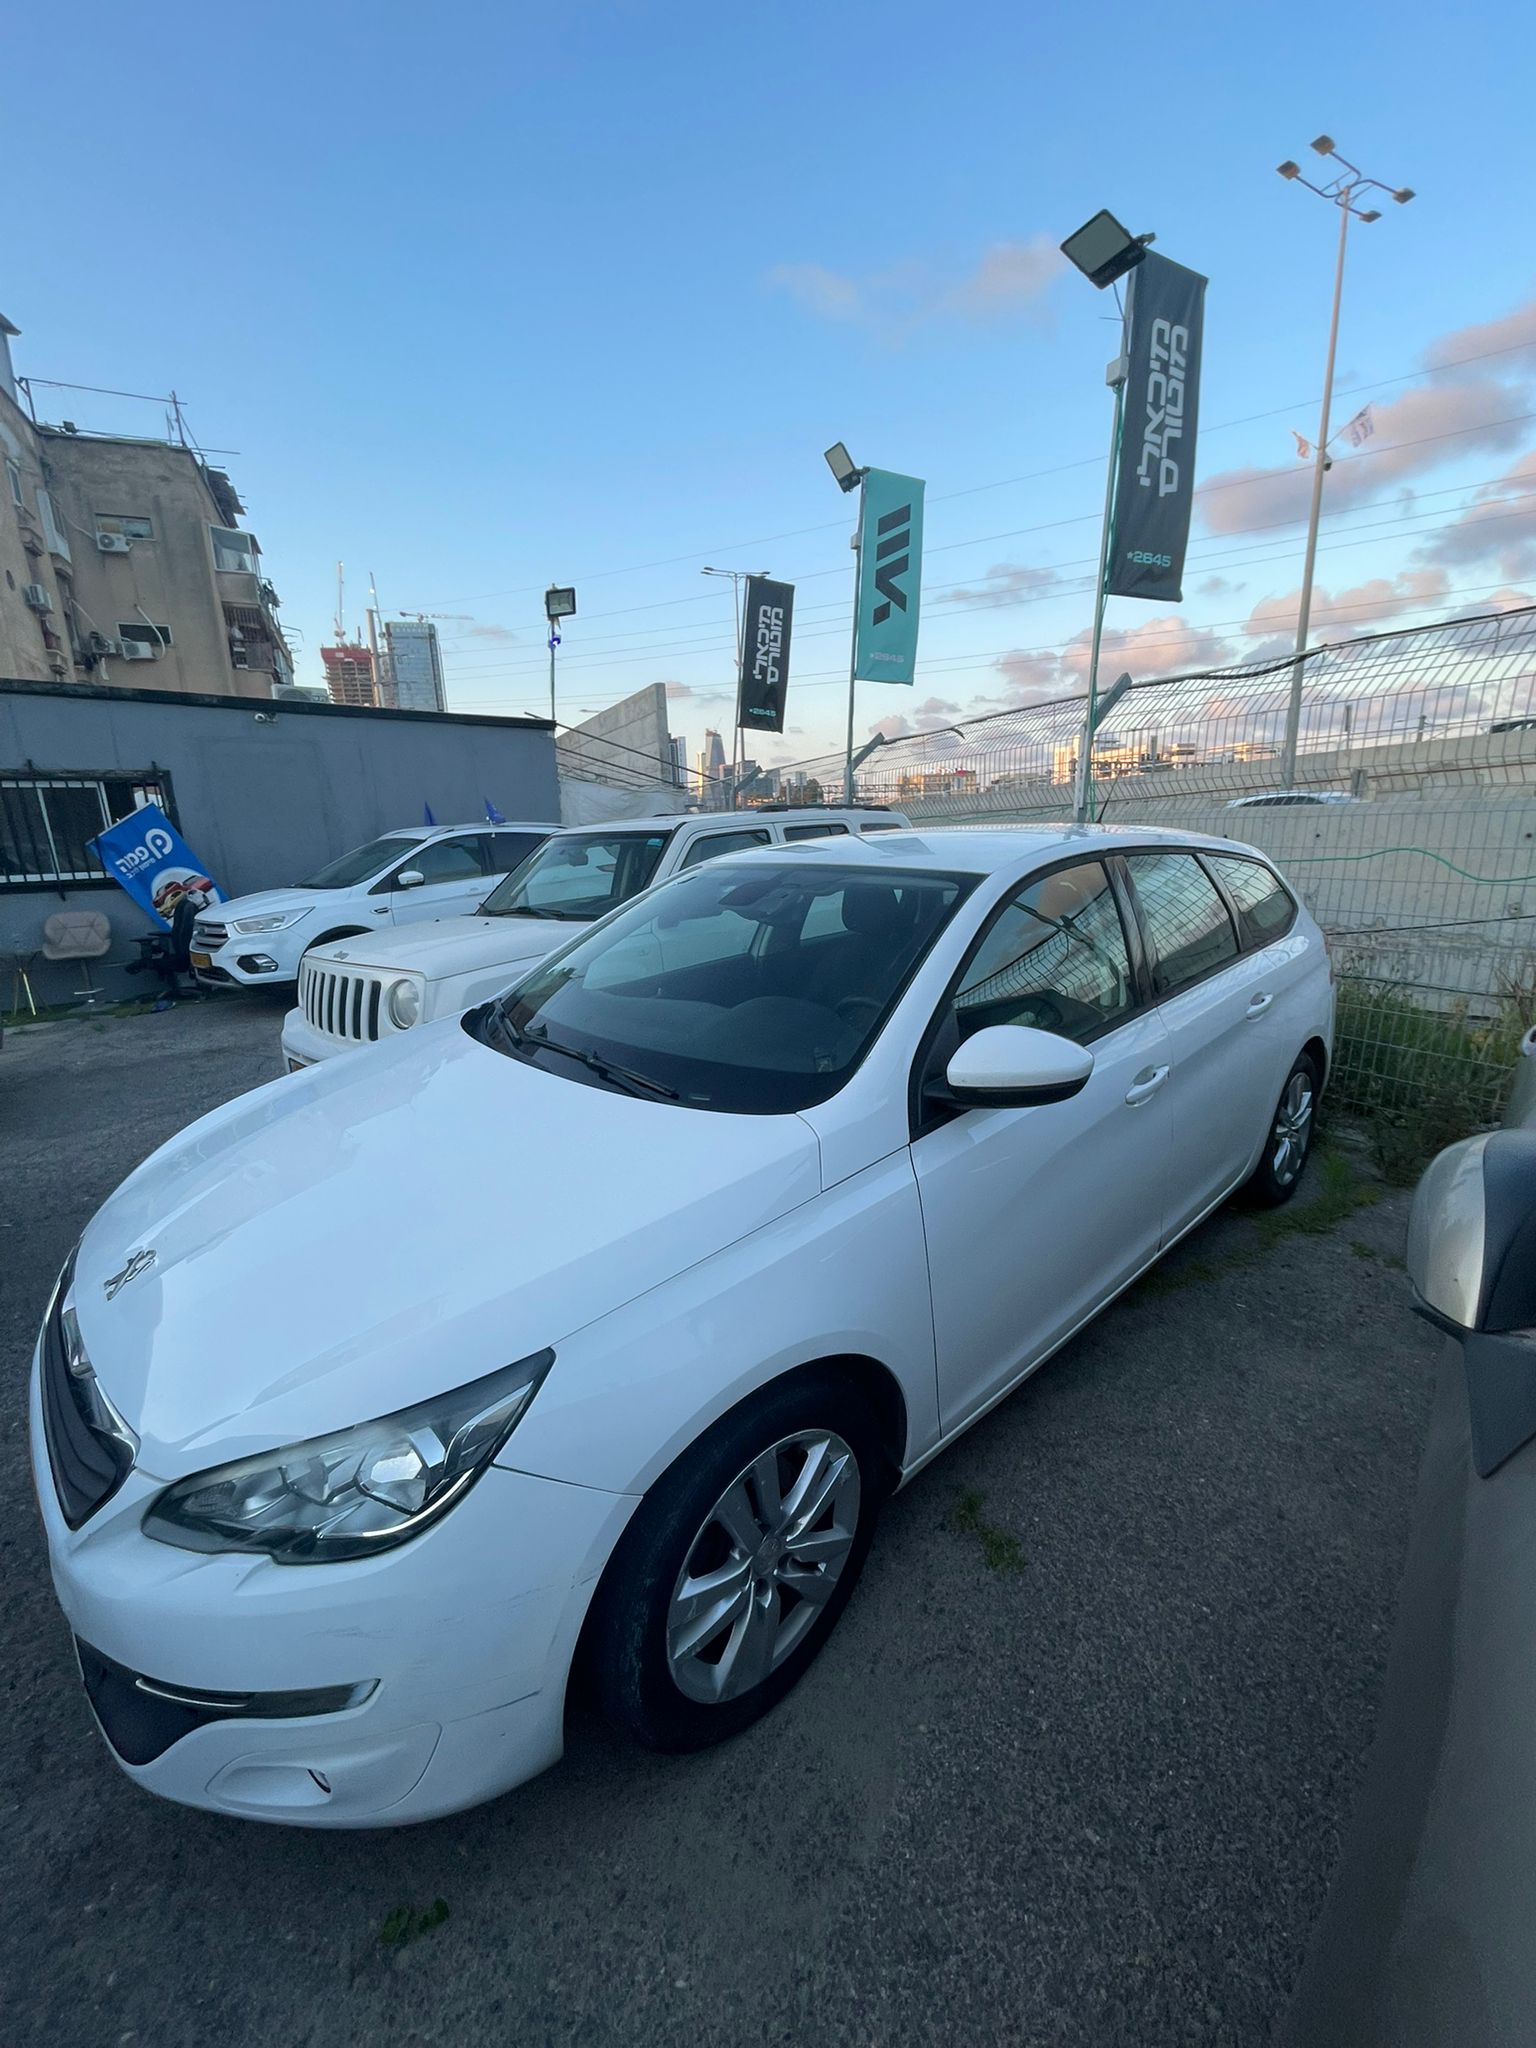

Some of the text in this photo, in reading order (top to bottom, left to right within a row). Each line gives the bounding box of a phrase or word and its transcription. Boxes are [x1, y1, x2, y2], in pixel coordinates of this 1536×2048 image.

[1137, 317, 1171, 487] מיכאלי
[1159, 323, 1189, 497] מוטורס
[752, 604, 772, 680] מיכאלי
[766, 607, 784, 685] מוטורס
[115, 846, 149, 873] פמה
